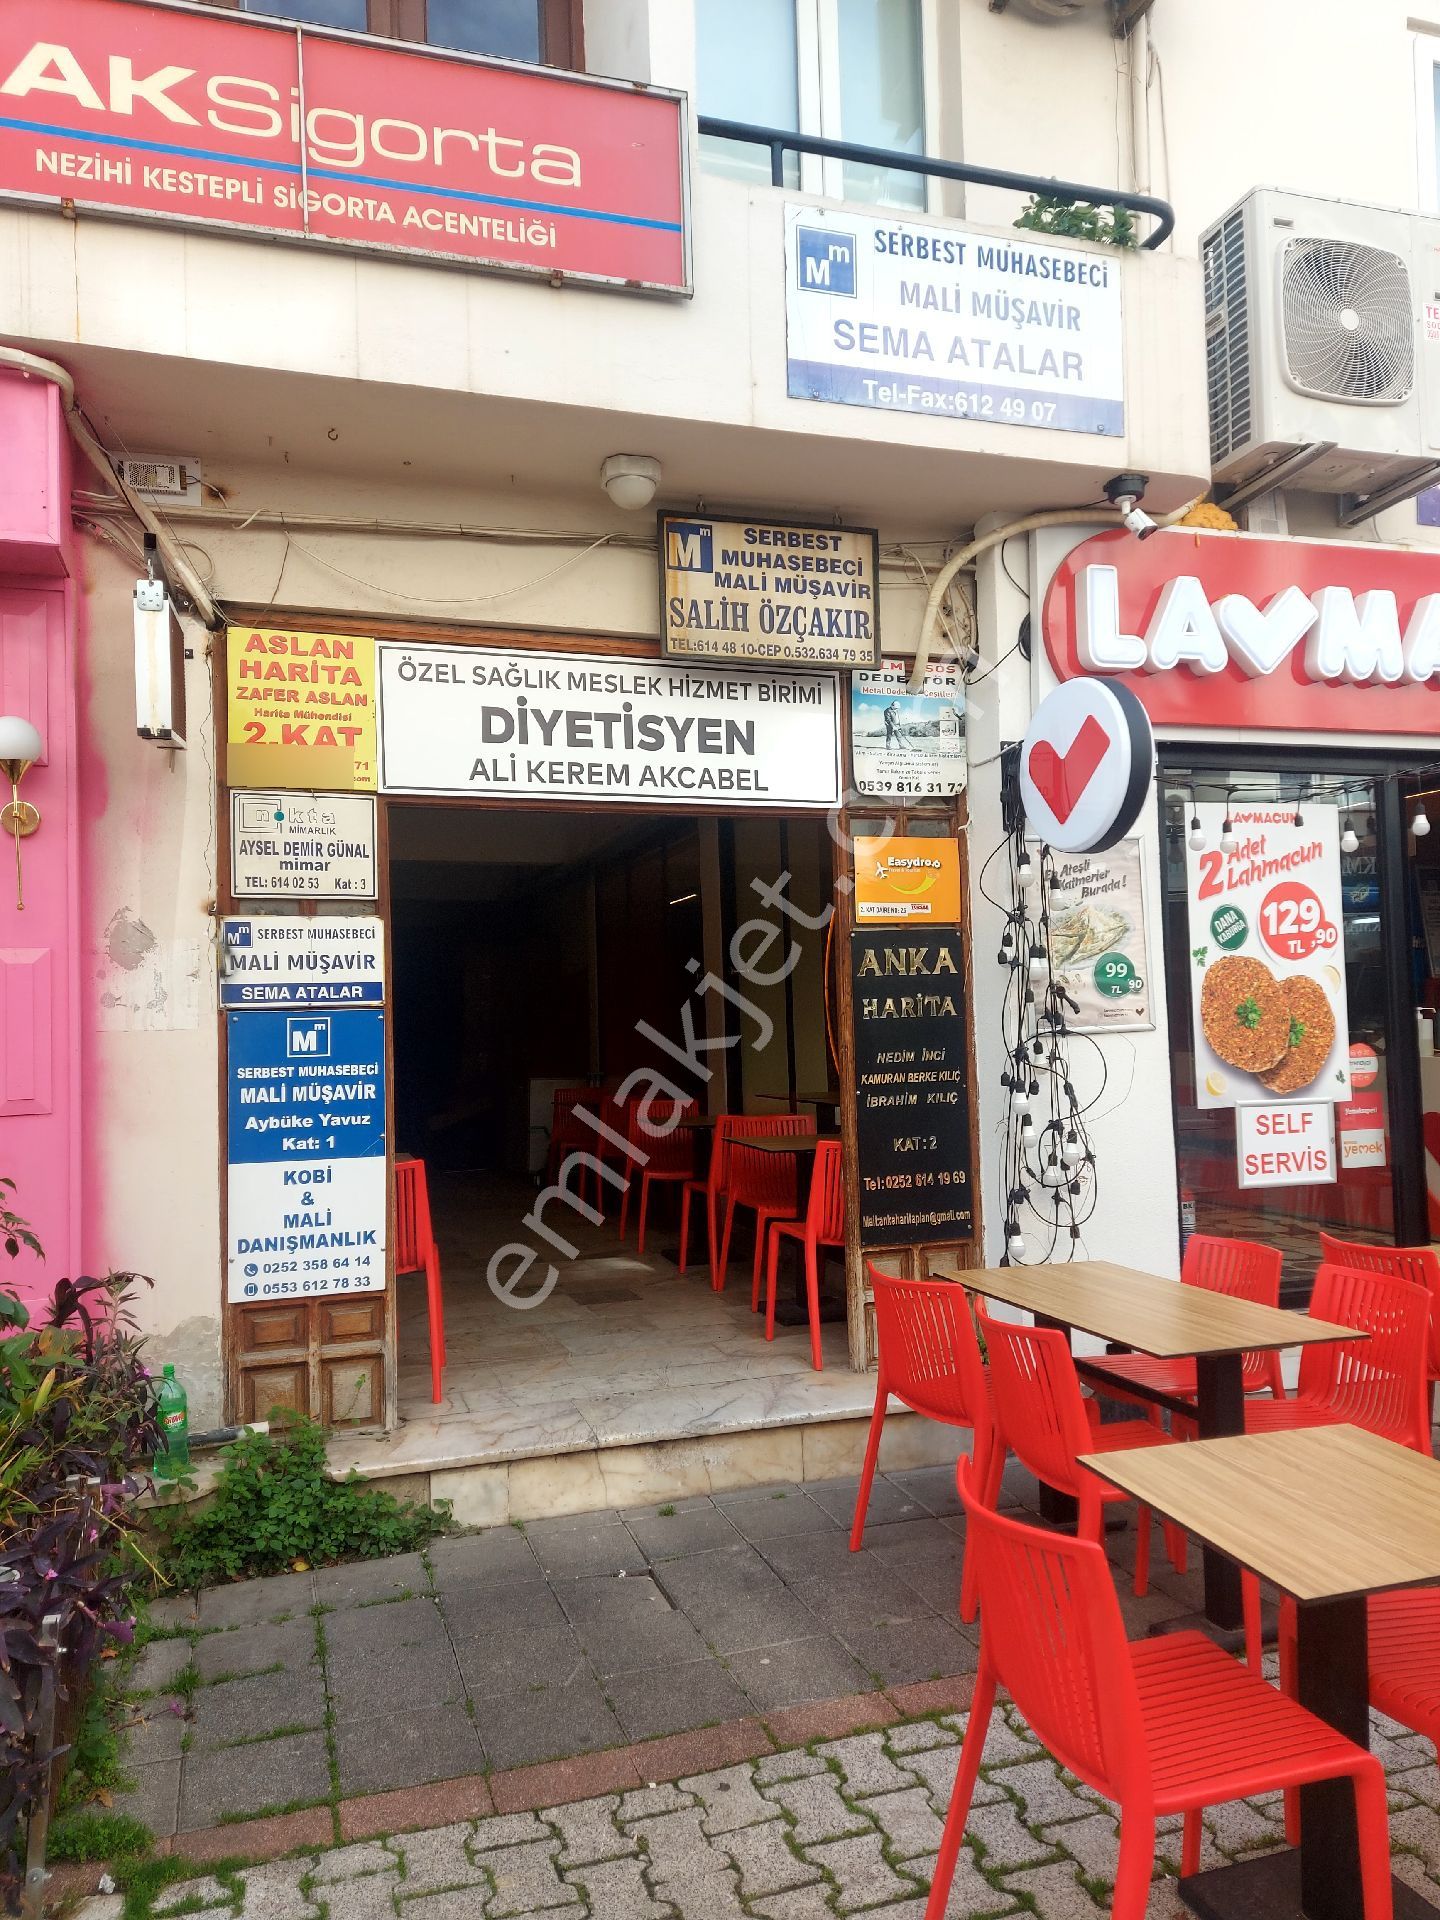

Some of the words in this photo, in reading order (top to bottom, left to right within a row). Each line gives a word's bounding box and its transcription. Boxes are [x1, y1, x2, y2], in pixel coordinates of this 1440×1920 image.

[35, 147, 132, 186] NEZİHİ
[143, 164, 264, 205] KESTEPLİ
[273, 180, 394, 224] SİGORTA
[402, 206, 556, 248] ACENTELİĞİ
[874, 229, 966, 265] SERBEST
[977, 245, 1108, 288] MUHASEBECİ
[900, 280, 961, 314] MALİ
[972, 289, 1081, 332] MÜŞAVİR
[833, 319, 934, 361] SEMA
[947, 336, 1083, 381] ATALAR
[1000, 398, 1025, 418] 49
[1032, 402, 1056, 422] 07
[743, 528, 842, 551] SERBEST
[721, 549, 863, 576] MUHASEBECİ
[714, 571, 767, 591] MALİ
[775, 575, 872, 600] MÜŞAVİR
[670, 596, 749, 633] SALİH
[759, 598, 872, 643] ÖZÇAKIR
[245, 633, 354, 659] ASLAN
[670, 637, 718, 653] TEL:614
[722, 640, 736, 654] 48
[844, 648, 856, 661] 79
[860, 650, 873, 662] 35
[240, 659, 362, 686] HARİTA
[398, 656, 465, 685] ÖZEL
[472, 663, 561, 691] SAĞLIK
[567, 672, 662, 697] MESLEK
[668, 674, 752, 701] HİZMET
[758, 678, 823, 705] BİRİMİ
[236, 686, 300, 703] ZAFER
[305, 690, 368, 707] ASLAN
[862, 686, 885, 694] Metal
[254, 708, 290, 719] Harita
[294, 709, 352, 721] Mühendisi
[481, 695, 756, 756] DİYETİSYEN
[243, 722, 363, 747] 2.KAT
[469, 753, 517, 783] ALİ
[526, 758, 630, 786] KEREM
[638, 765, 769, 792] AKCABEL
[859, 781, 892, 791] 0539
[896, 782, 922, 793] 816
[927, 782, 942, 793] 31
[289, 825, 336, 835] MİMARLIK
[239, 839, 279, 856] AYSEL
[283, 839, 323, 857] DEMİR
[327, 840, 370, 859] GÜNAL
[1227, 834, 1267, 864] Adet
[279, 858, 331, 871] mimar
[1060, 859, 1091, 877] Ateşli
[1198, 850, 1224, 901] 2
[1227, 842, 1323, 890] Lahmacun
[245, 877, 268, 888] TEL:
[271, 876, 289, 889] 614
[292, 877, 304, 889] 02
[308, 878, 319, 889] 53
[361, 879, 366, 890] 3
[1214, 910, 1239, 933] DANA
[1263, 898, 1320, 935] 129
[257, 928, 304, 940] SERBEST
[307, 926, 376, 940] MUHASEBECİ
[1217, 919, 1246, 944] KABURGA
[1287, 940, 1306, 953] TL
[230, 951, 278, 971] MALİ
[287, 950, 376, 974] MÜŞAVİR
[857, 947, 958, 977] ANKA
[1105, 962, 1128, 978] 99
[241, 986, 291, 1000] SEMA
[295, 985, 363, 999] ATALAR
[1111, 985, 1122, 994] TL
[862, 993, 958, 1020] HARİTA
[877, 1049, 915, 1064] NEDİM
[921, 1047, 946, 1062] İNCİ
[237, 1067, 294, 1079] SERBEST
[298, 1062, 379, 1077] MUHASEBECİ
[861, 1073, 906, 1085] KAMURAN
[907, 1071, 937, 1083] BERKE
[938, 1069, 960, 1083] KILIÇ
[240, 1082, 286, 1104] MALİ
[292, 1080, 376, 1104] MÜŞAVİR
[866, 1091, 918, 1108] İBRAHİM
[926, 1092, 958, 1105] KILIÇ
[245, 1115, 314, 1132] Aybüke
[319, 1113, 371, 1127] Yavuz
[1256, 1112, 1313, 1135] SELF
[282, 1136, 320, 1151] Kat:
[326, 1136, 335, 1149] 1
[1245, 1145, 1328, 1176] SERVİS
[283, 1165, 332, 1186] KOBİ
[915, 1172, 934, 1187] 614
[937, 1171, 950, 1185] 19
[952, 1170, 966, 1184] 69
[300, 1191, 314, 1206] &
[283, 1208, 332, 1229] MALİ
[237, 1229, 377, 1255] DANIŞMANLIK
[263, 1261, 298, 1274] 0252
[303, 1259, 328, 1271] 358
[332, 1257, 349, 1268] 64
[354, 1255, 370, 1267] 14
[263, 1281, 298, 1295] 0553
[303, 1279, 328, 1291] 612
[332, 1277, 349, 1289] 78
[354, 1276, 371, 1287] 33
